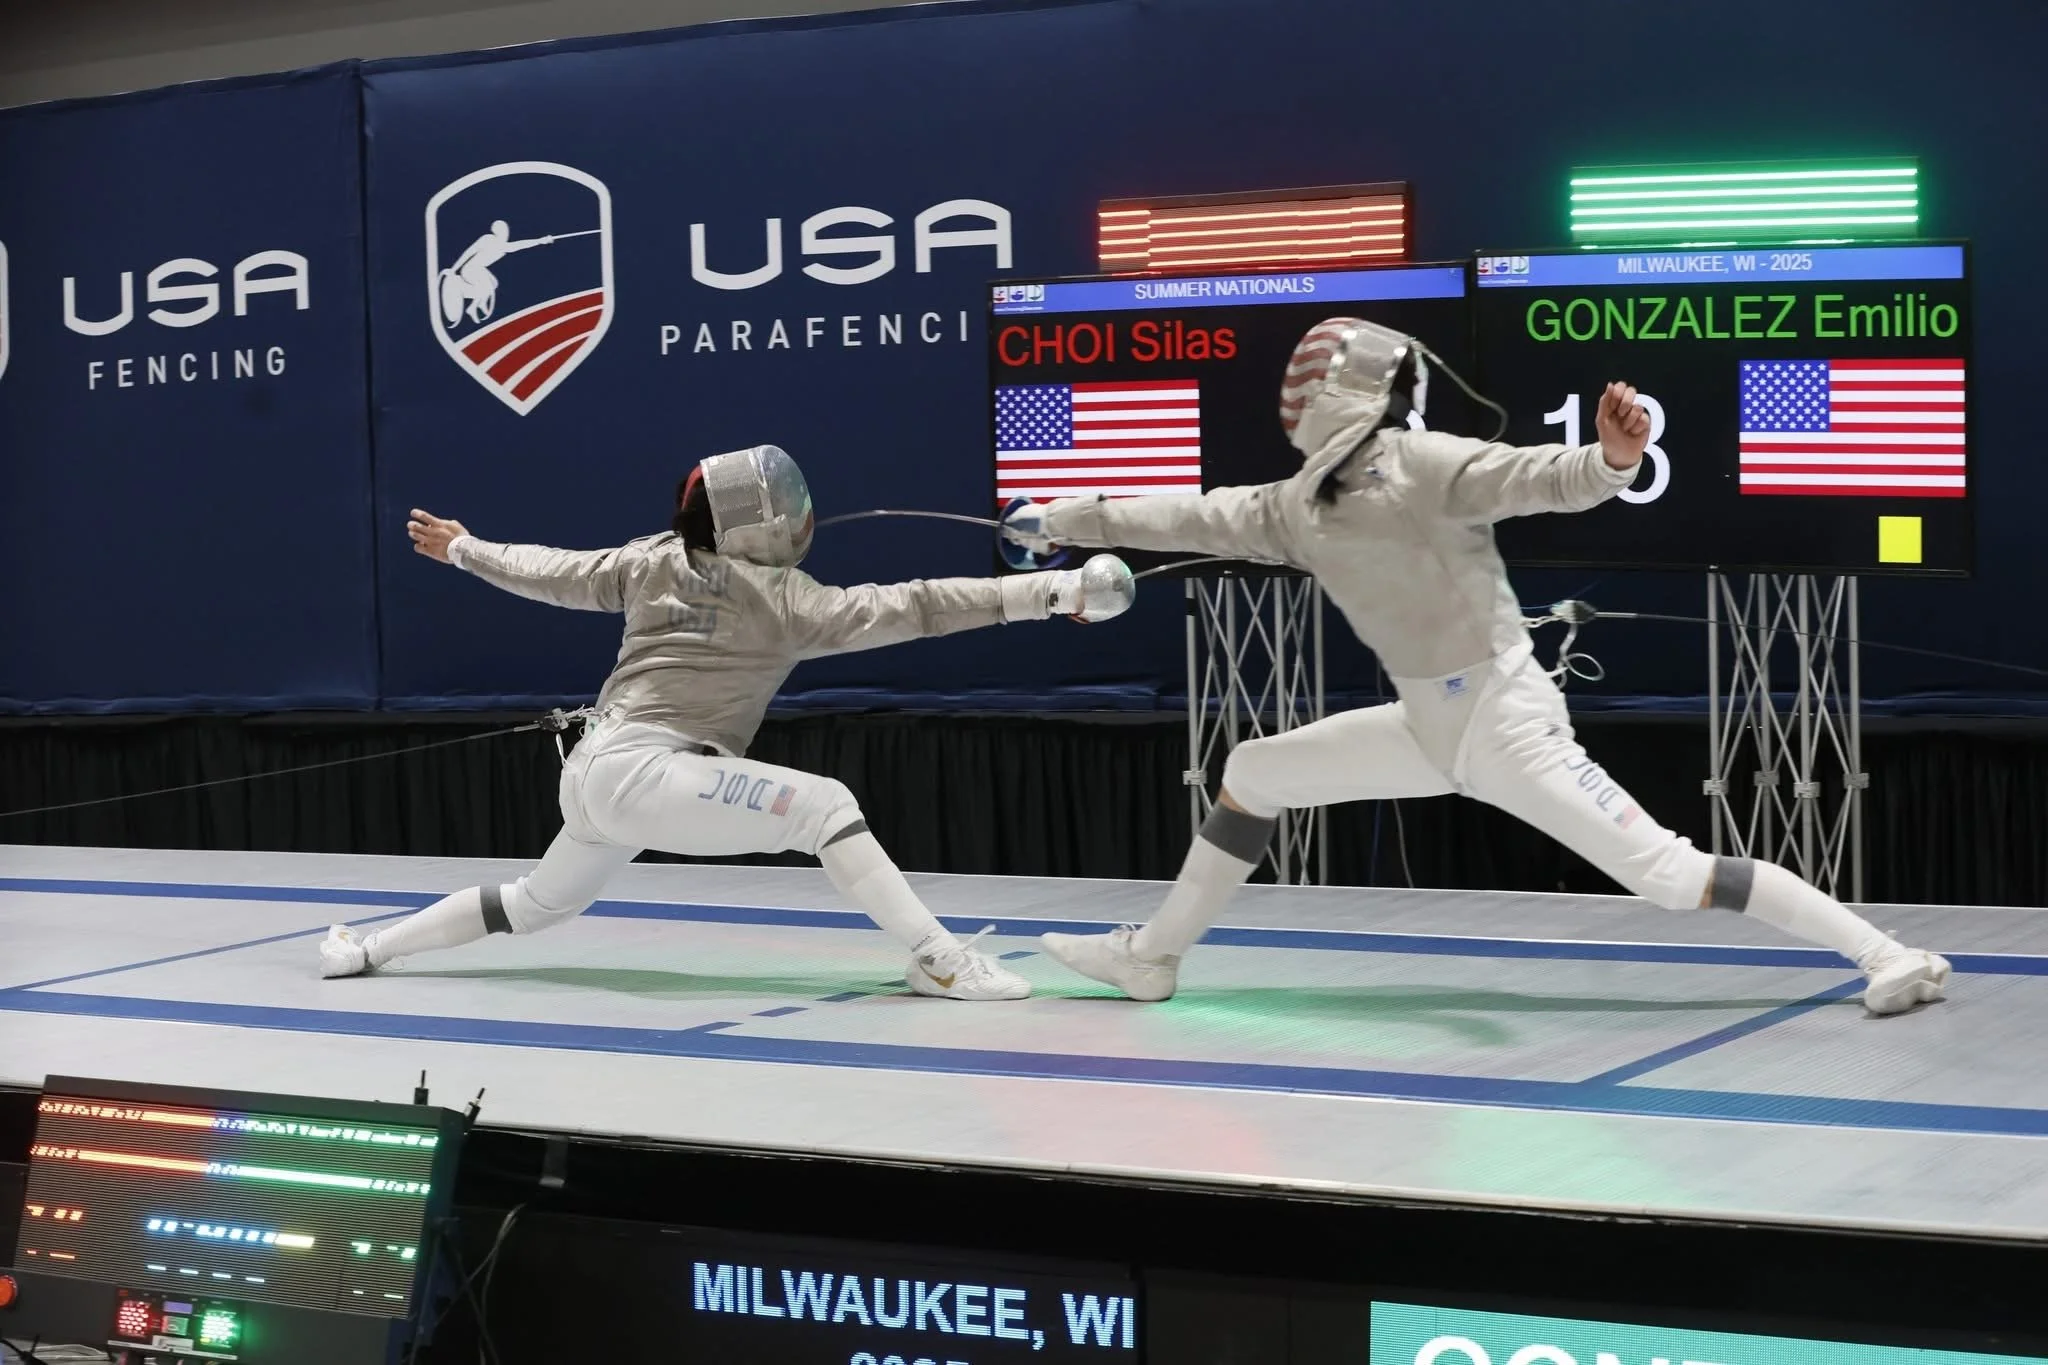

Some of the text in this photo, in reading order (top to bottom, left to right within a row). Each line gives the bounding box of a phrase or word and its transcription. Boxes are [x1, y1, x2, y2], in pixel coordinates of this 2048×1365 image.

[690, 199, 1012, 290] USA
[1617, 256, 1728, 275] MILWAUKEE,
[1733, 255, 1757, 272] WI
[1770, 253, 1813, 271] 2025
[63, 250, 309, 336] USA
[1135, 277, 1316, 299] SUMMER NATIONALS
[1527, 294, 1957, 341] GONZALEZ Emilio
[999, 320, 1236, 366] CHOI Silas
[89, 347, 284, 389] FENCING
[694, 1263, 1134, 1350] MILWAUKEE, WI
